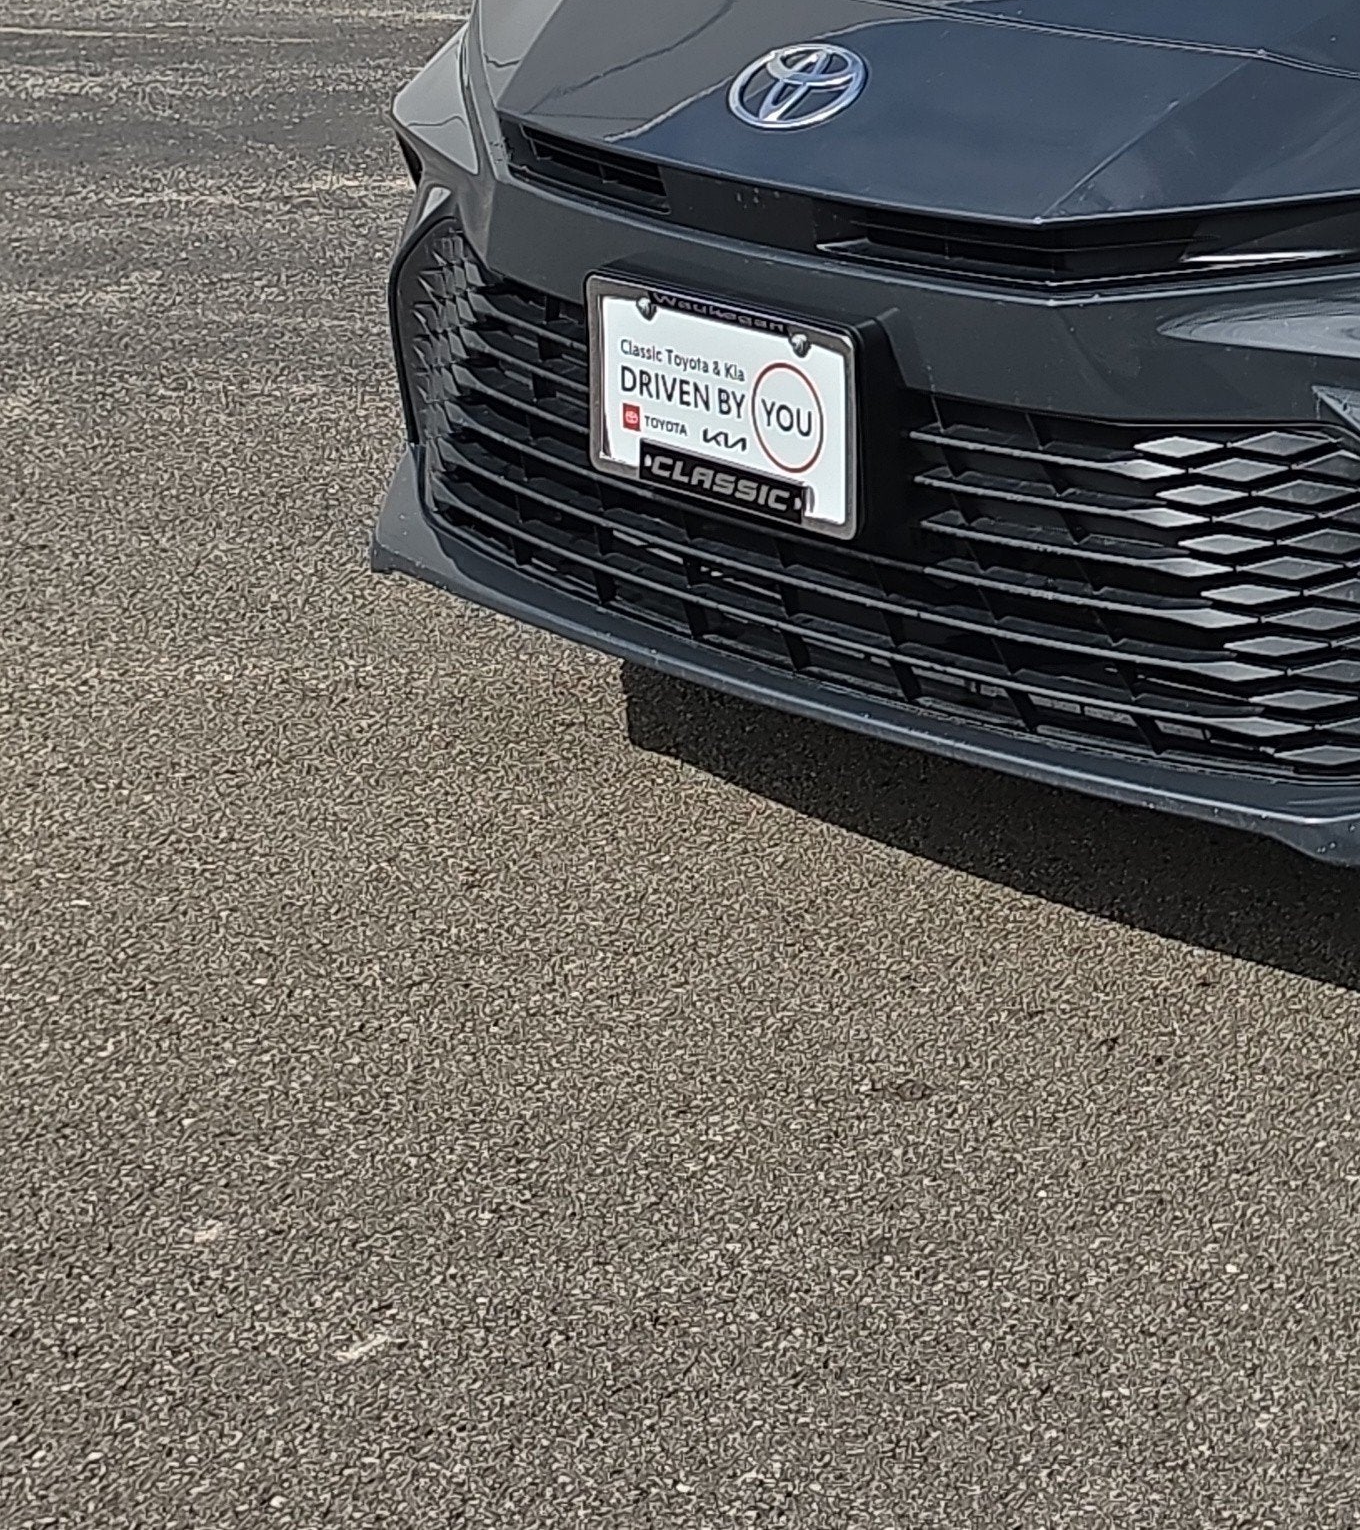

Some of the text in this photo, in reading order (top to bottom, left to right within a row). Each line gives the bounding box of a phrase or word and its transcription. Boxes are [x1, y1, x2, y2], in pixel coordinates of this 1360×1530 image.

[652, 292, 784, 332] Waukegan
[620, 338, 746, 382] Classic Toyota & Kia
[620, 364, 813, 438] DRIVEN BY YOU
[644, 415, 688, 437] TOYOTA
[651, 455, 791, 511] CLASSIC
